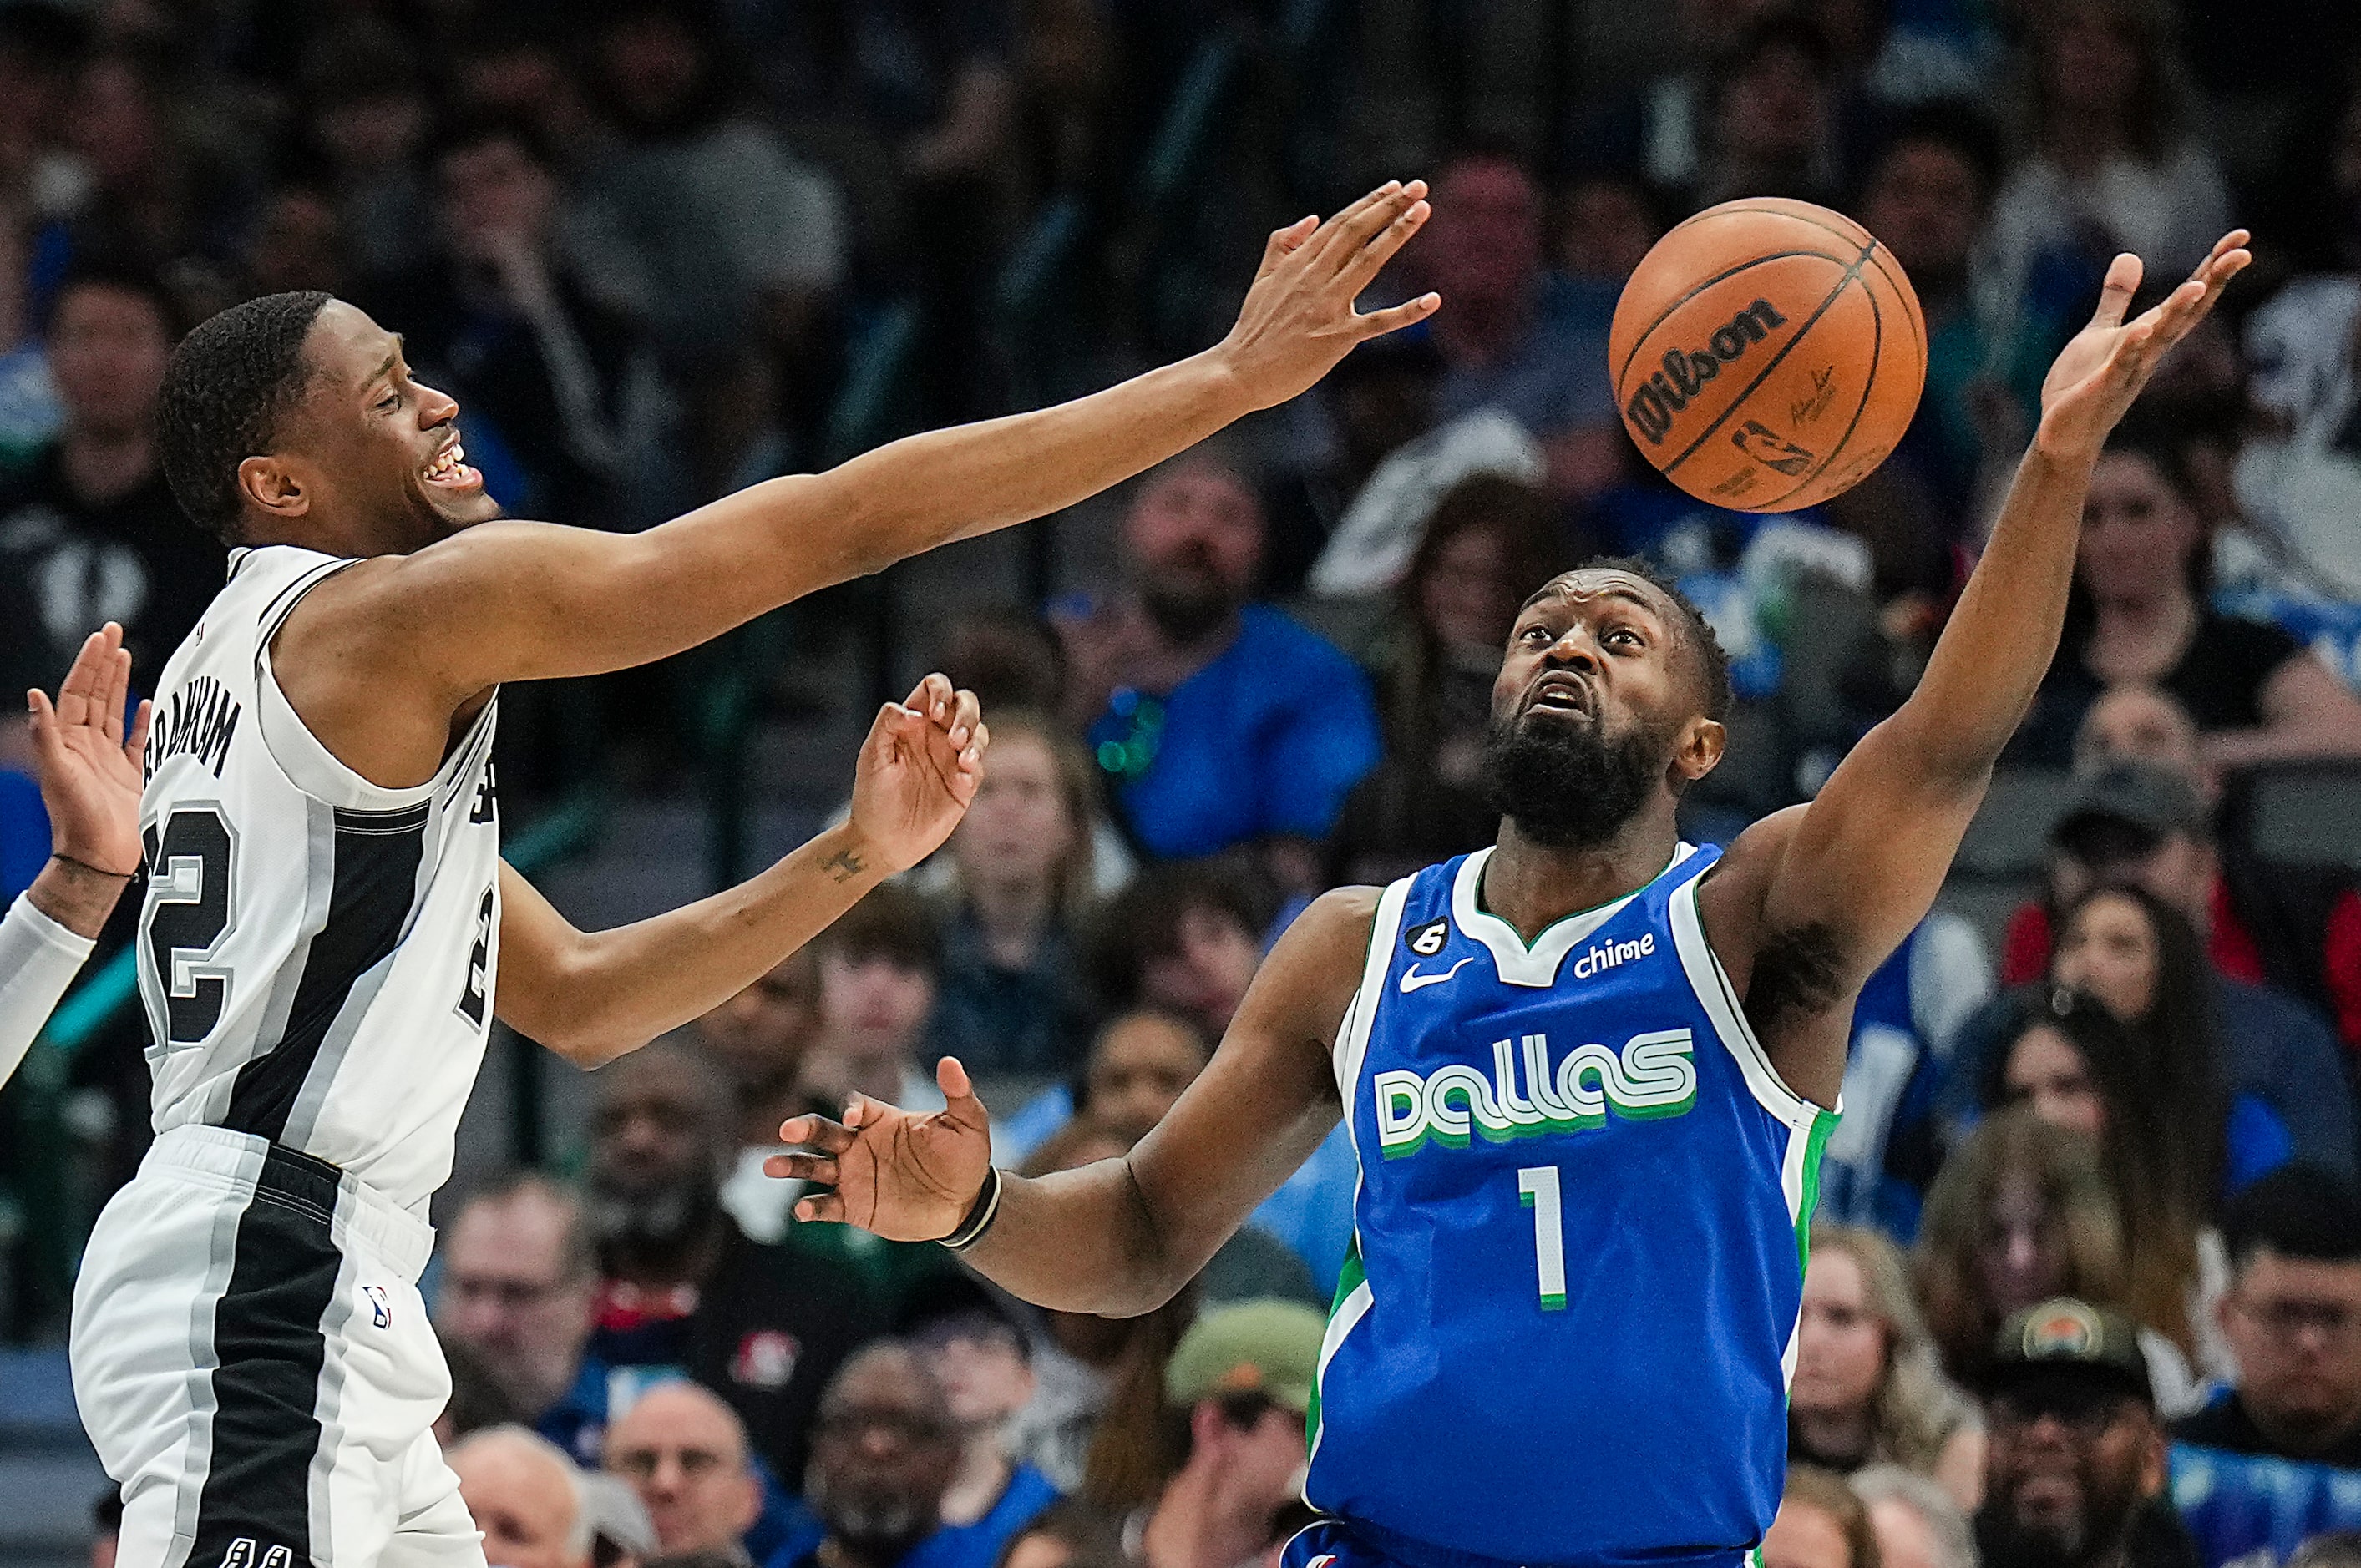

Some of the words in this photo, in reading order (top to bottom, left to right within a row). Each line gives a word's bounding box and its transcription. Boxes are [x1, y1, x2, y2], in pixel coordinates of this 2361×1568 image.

[1627, 297, 1789, 446] Wilson
[139, 799, 241, 1054] 2
[1412, 923, 1446, 954] 6
[1573, 933, 1655, 979] chime
[1374, 1028, 1697, 1159] Dallas
[1517, 1166, 1567, 1310] 1
